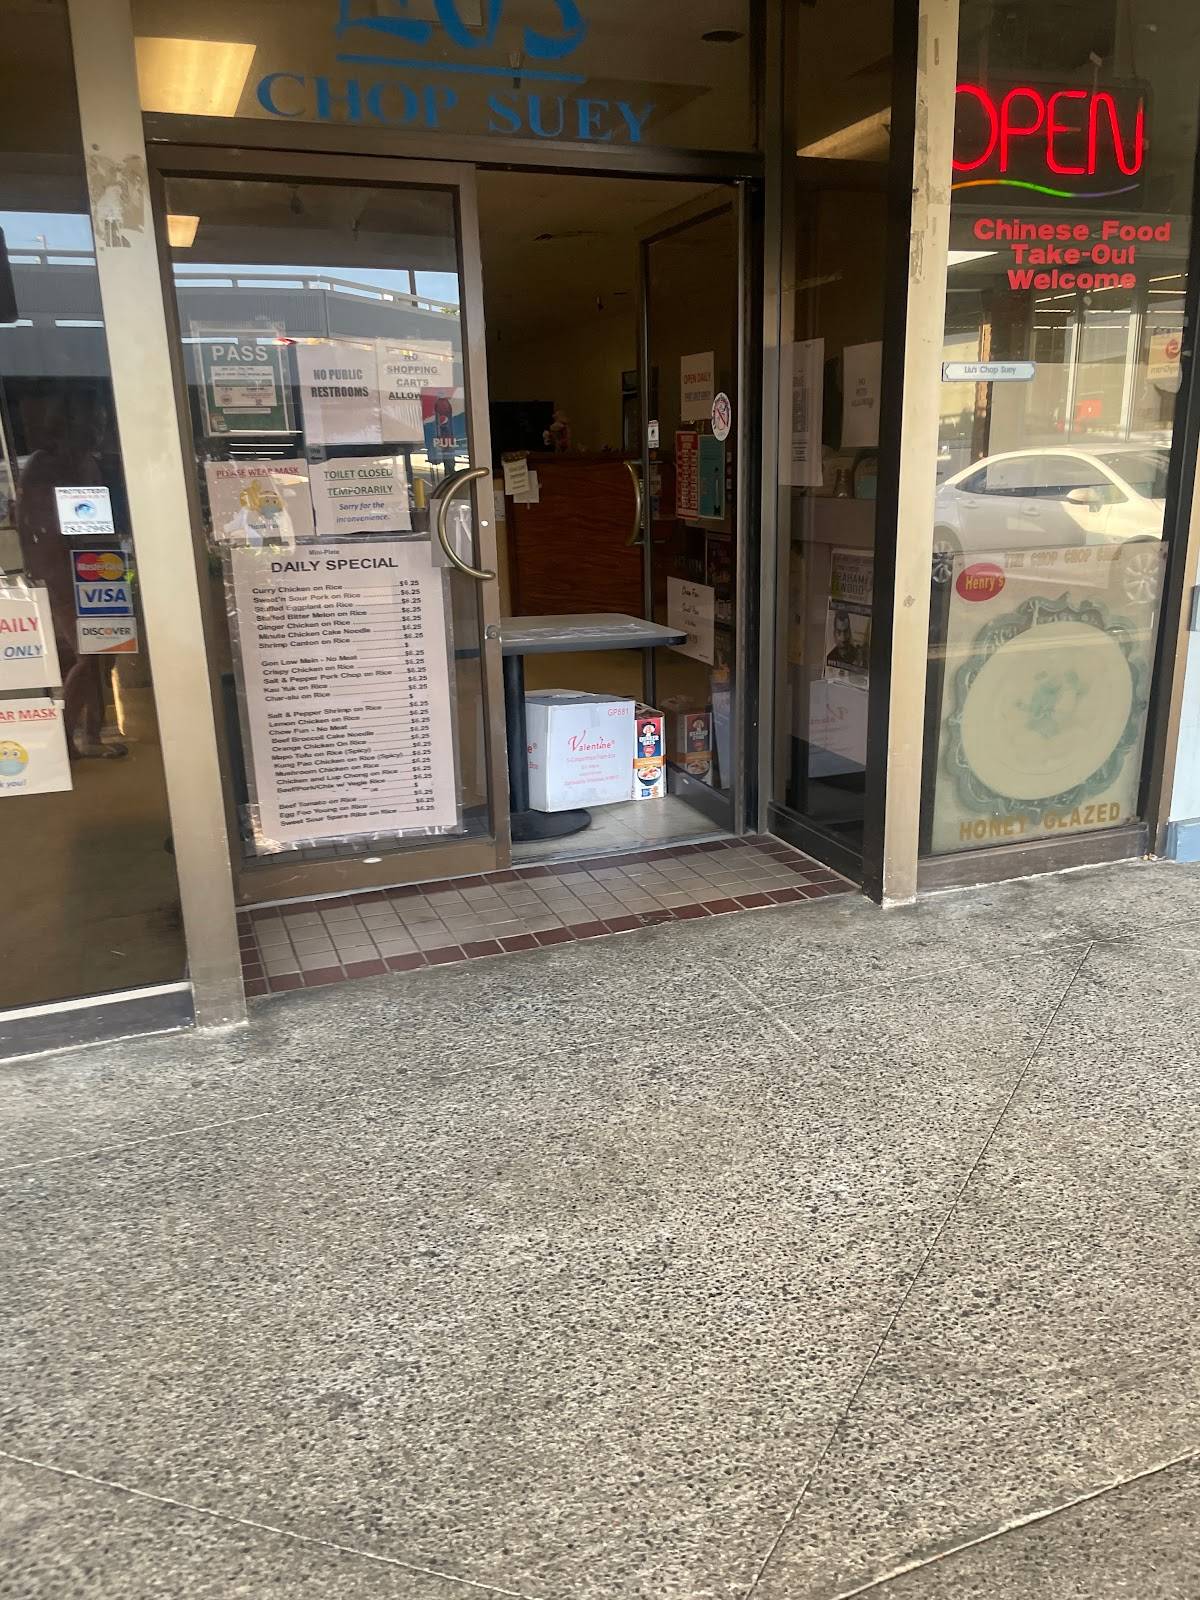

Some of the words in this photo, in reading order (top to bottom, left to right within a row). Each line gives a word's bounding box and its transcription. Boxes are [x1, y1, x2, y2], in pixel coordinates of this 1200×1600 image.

[256, 71, 458, 128] CHOP
[487, 94, 656, 143] SUEY
[952, 84, 1144, 176] OPEN
[974, 218, 1089, 241] Chinese
[1102, 220, 1171, 241] Food
[1011, 243, 1136, 265] Take-Out
[1007, 269, 1136, 290] Welcome
[212, 345, 268, 361] PASS
[313, 369, 327, 380] NO
[329, 369, 363, 380] PUBLIC
[387, 366, 438, 375] SHOPPING
[396, 379, 429, 387] CARTS
[311, 386, 369, 398] RESTROOMS
[433, 437, 459, 448] PULL
[275, 466, 299, 476] MASK
[324, 470, 356, 479] TOILET
[358, 469, 392, 478] CLOSED
[328, 485, 392, 496] TEMPORARILY
[339, 503, 358, 511] Sorry
[360, 502, 371, 510] for
[271, 560, 320, 573] DAILY
[326, 557, 399, 570] SPECIAL
[84, 588, 127, 603] VISA
[0, 617, 38, 633] AILY
[83, 627, 131, 636] DISCOVER
[4, 645, 42, 658] ONLY
[19, 708, 57, 720] MASK
[959, 814, 1028, 841] HONEY
[1043, 802, 1120, 831] GLAZED
